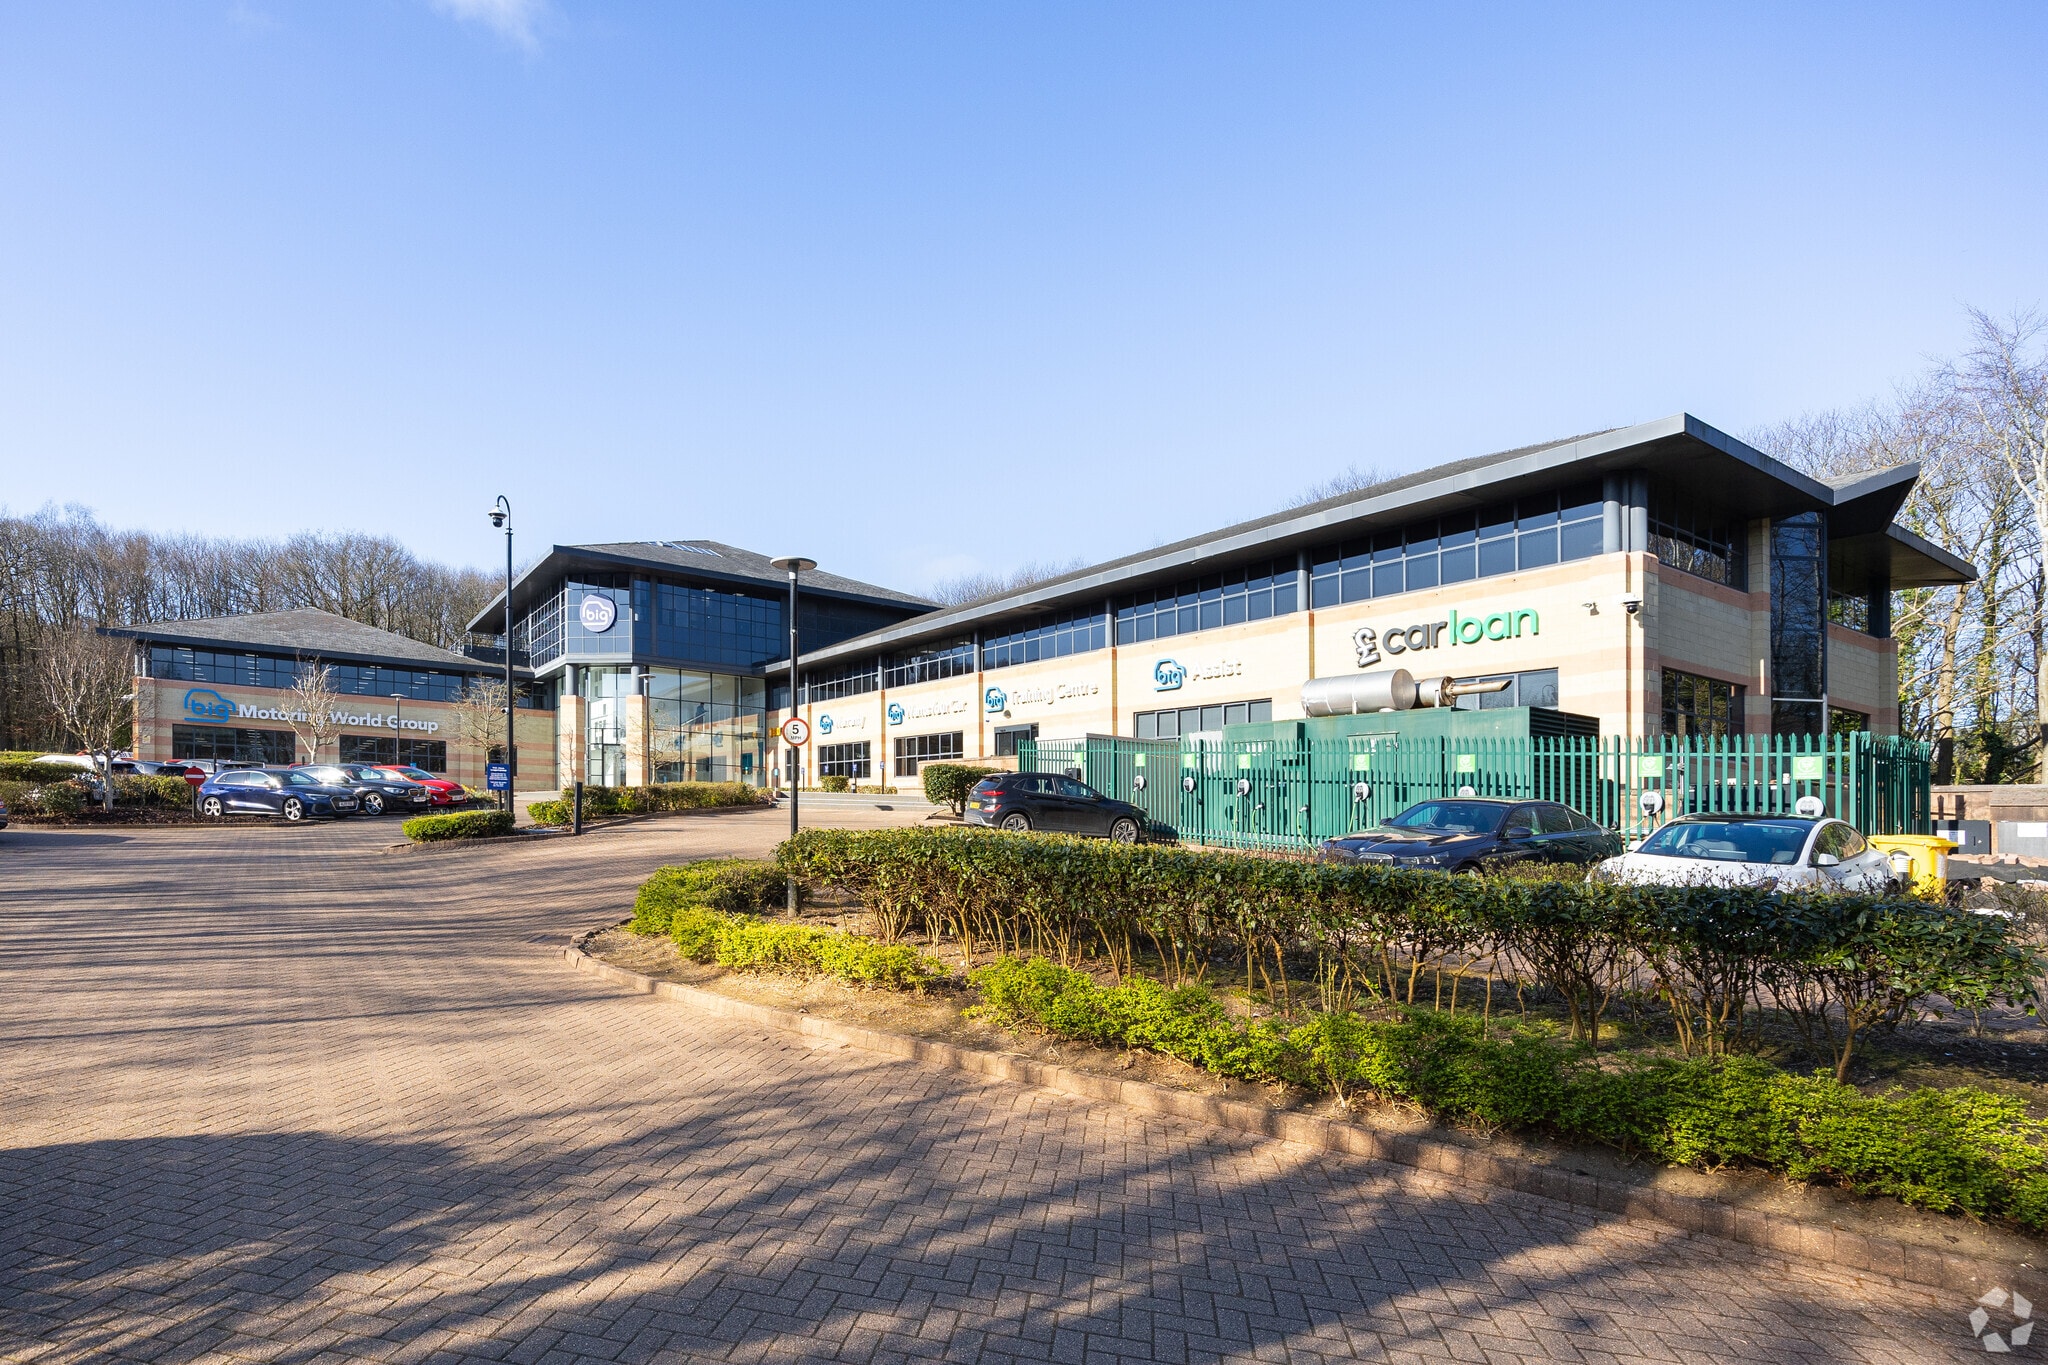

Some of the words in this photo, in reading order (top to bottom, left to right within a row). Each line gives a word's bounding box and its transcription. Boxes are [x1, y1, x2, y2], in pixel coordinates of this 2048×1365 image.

[583, 609, 609, 625] big
[1155, 669, 1182, 692] big
[1191, 659, 1242, 681] Assist
[185, 699, 229, 723] big
[329, 710, 382, 727] World
[386, 715, 438, 734] Group
[792, 724, 800, 735] 5
